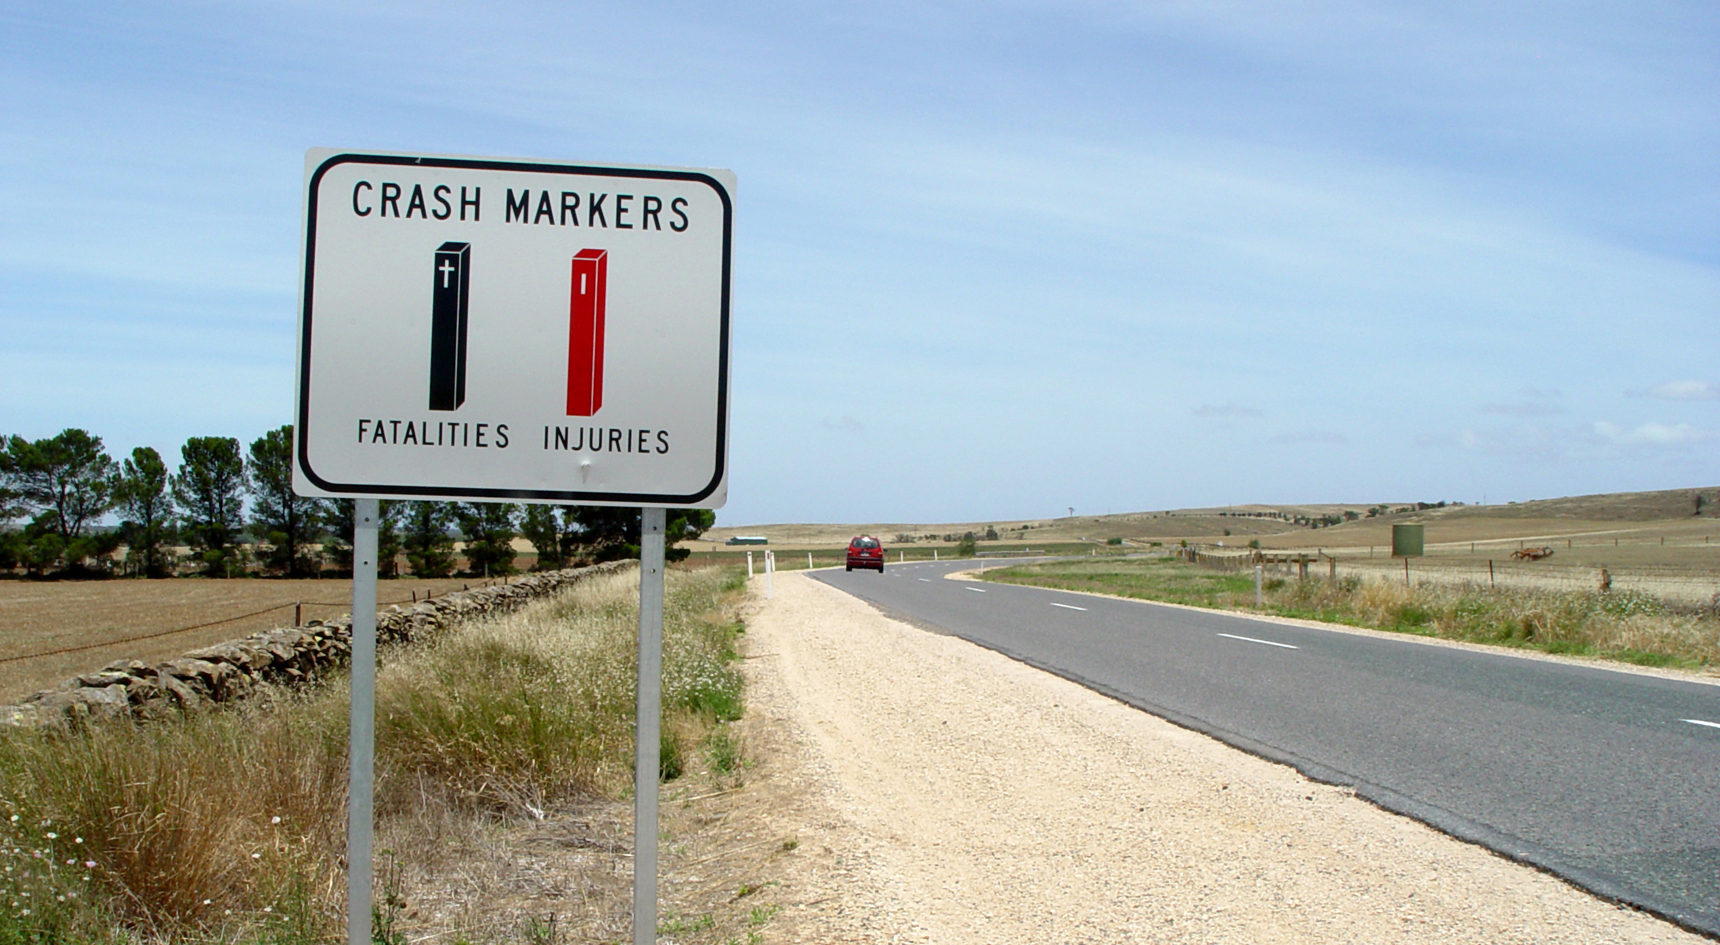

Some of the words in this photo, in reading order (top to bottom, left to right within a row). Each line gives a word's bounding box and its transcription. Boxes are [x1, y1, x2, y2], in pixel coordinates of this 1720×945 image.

[352, 180, 481, 222] CRASH
[505, 188, 689, 233] MARKERS
[358, 418, 509, 449] FATALITIES
[544, 425, 669, 455] INJURIES
